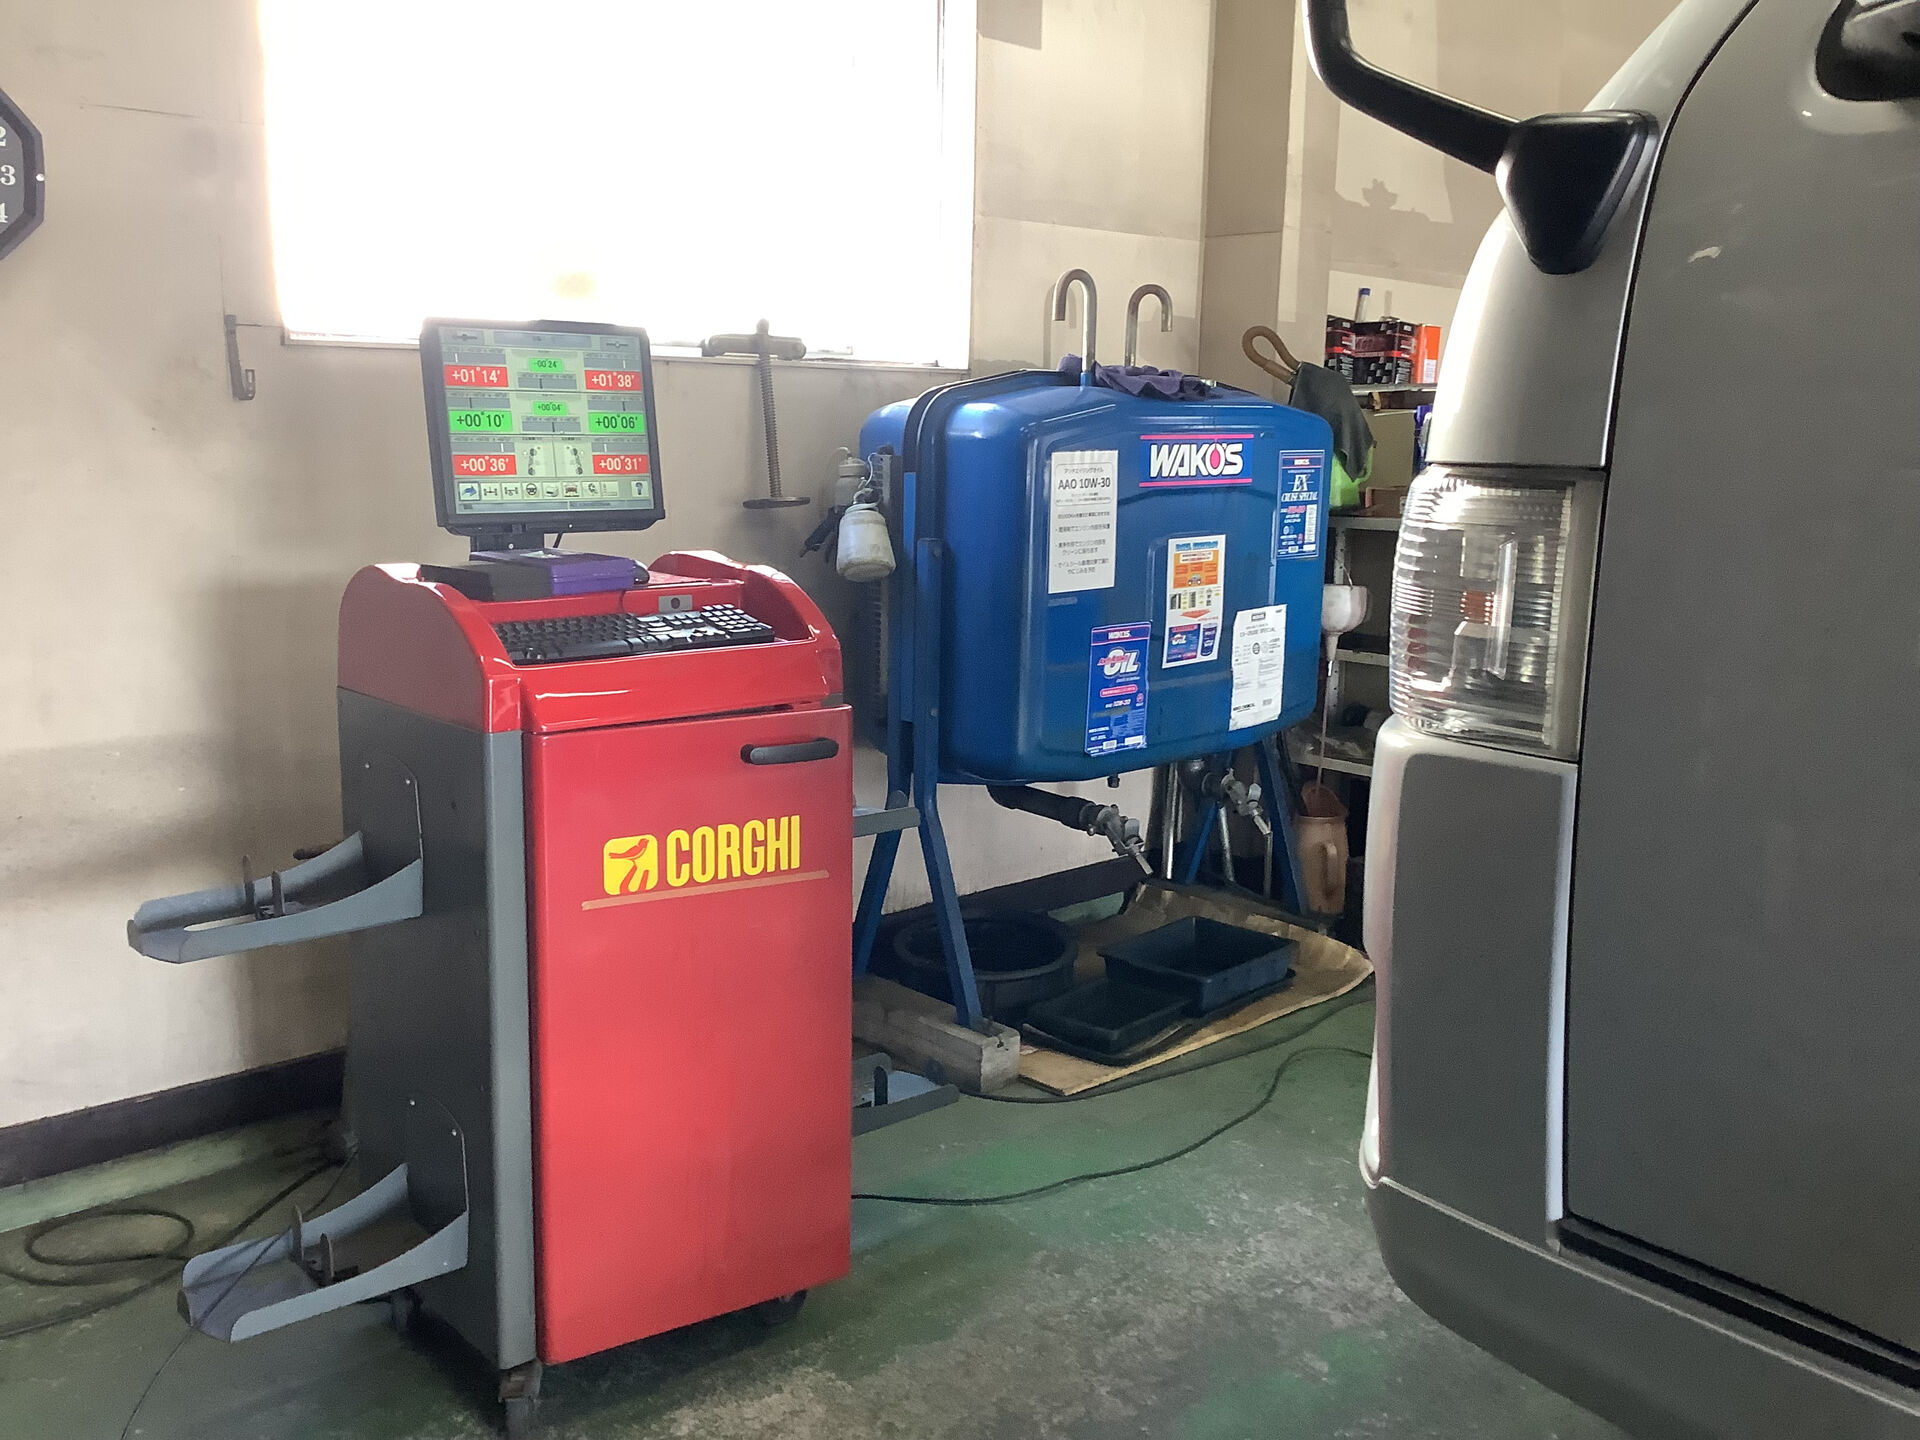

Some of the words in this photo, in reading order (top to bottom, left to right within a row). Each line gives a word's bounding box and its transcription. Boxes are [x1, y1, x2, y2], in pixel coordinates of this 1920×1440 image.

[1, 165, 16, 186] 3
[1150, 443, 1243, 478] WAKO'S
[1058, 478, 1077, 490] AAO
[1079, 477, 1111, 489] 10W-30
[1104, 649, 1139, 676] OIL
[666, 815, 800, 887] CORGHI
